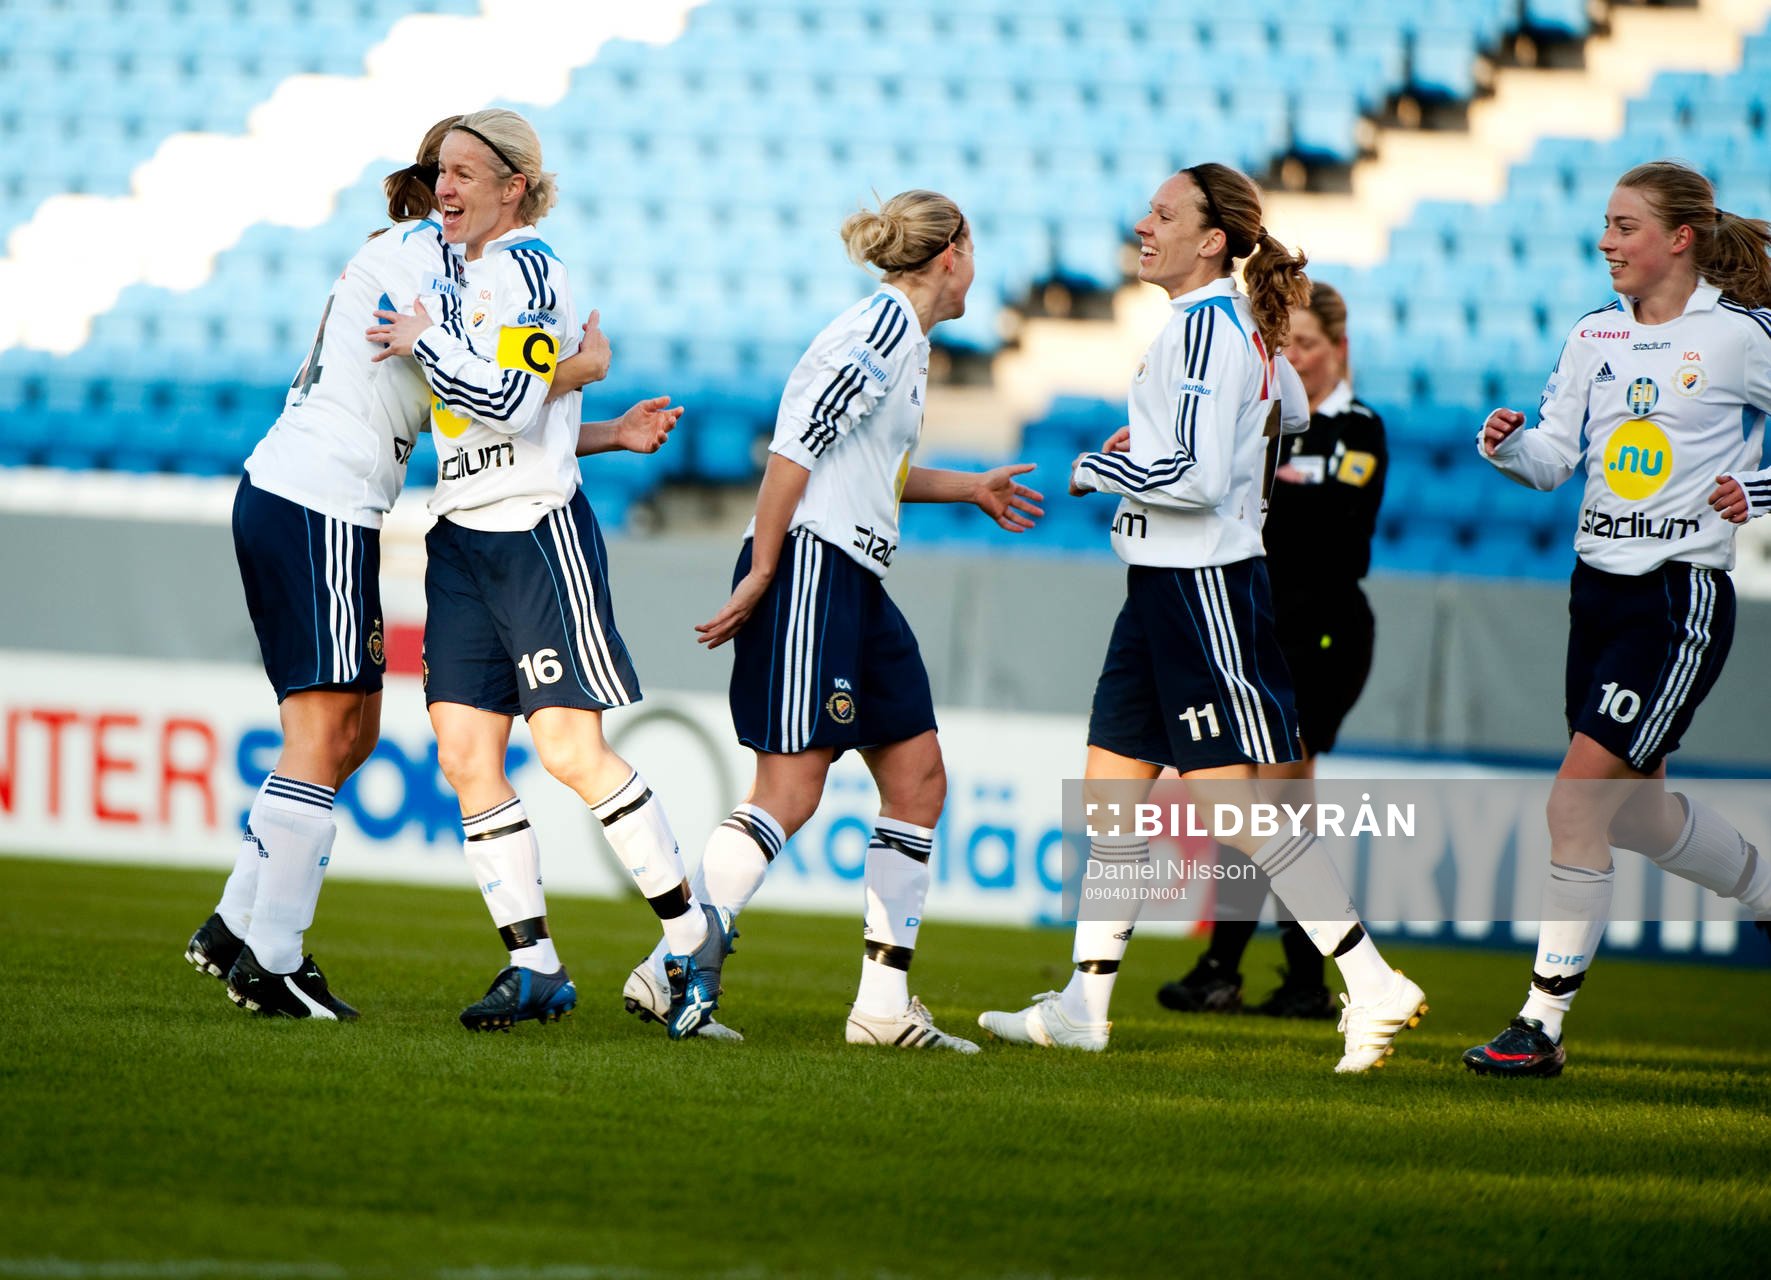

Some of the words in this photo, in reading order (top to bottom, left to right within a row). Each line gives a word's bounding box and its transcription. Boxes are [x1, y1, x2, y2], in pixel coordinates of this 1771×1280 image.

[1580, 329, 1631, 340] Canon
[523, 333, 554, 374] C
[1632, 341, 1671, 351] stadium
[1683, 351, 1701, 361] ICA
[1594, 374, 1616, 383] adidas
[1181, 384, 1211, 395] autilus
[441, 442, 515, 481] dium
[1609, 446, 1663, 476] .nu
[1581, 505, 1700, 539] stadium
[518, 648, 563, 690] 16
[834, 678, 851, 690] ICA
[1597, 681, 1641, 723] 10
[1179, 703, 1220, 741] 11
[1545, 952, 1584, 965] DIF
